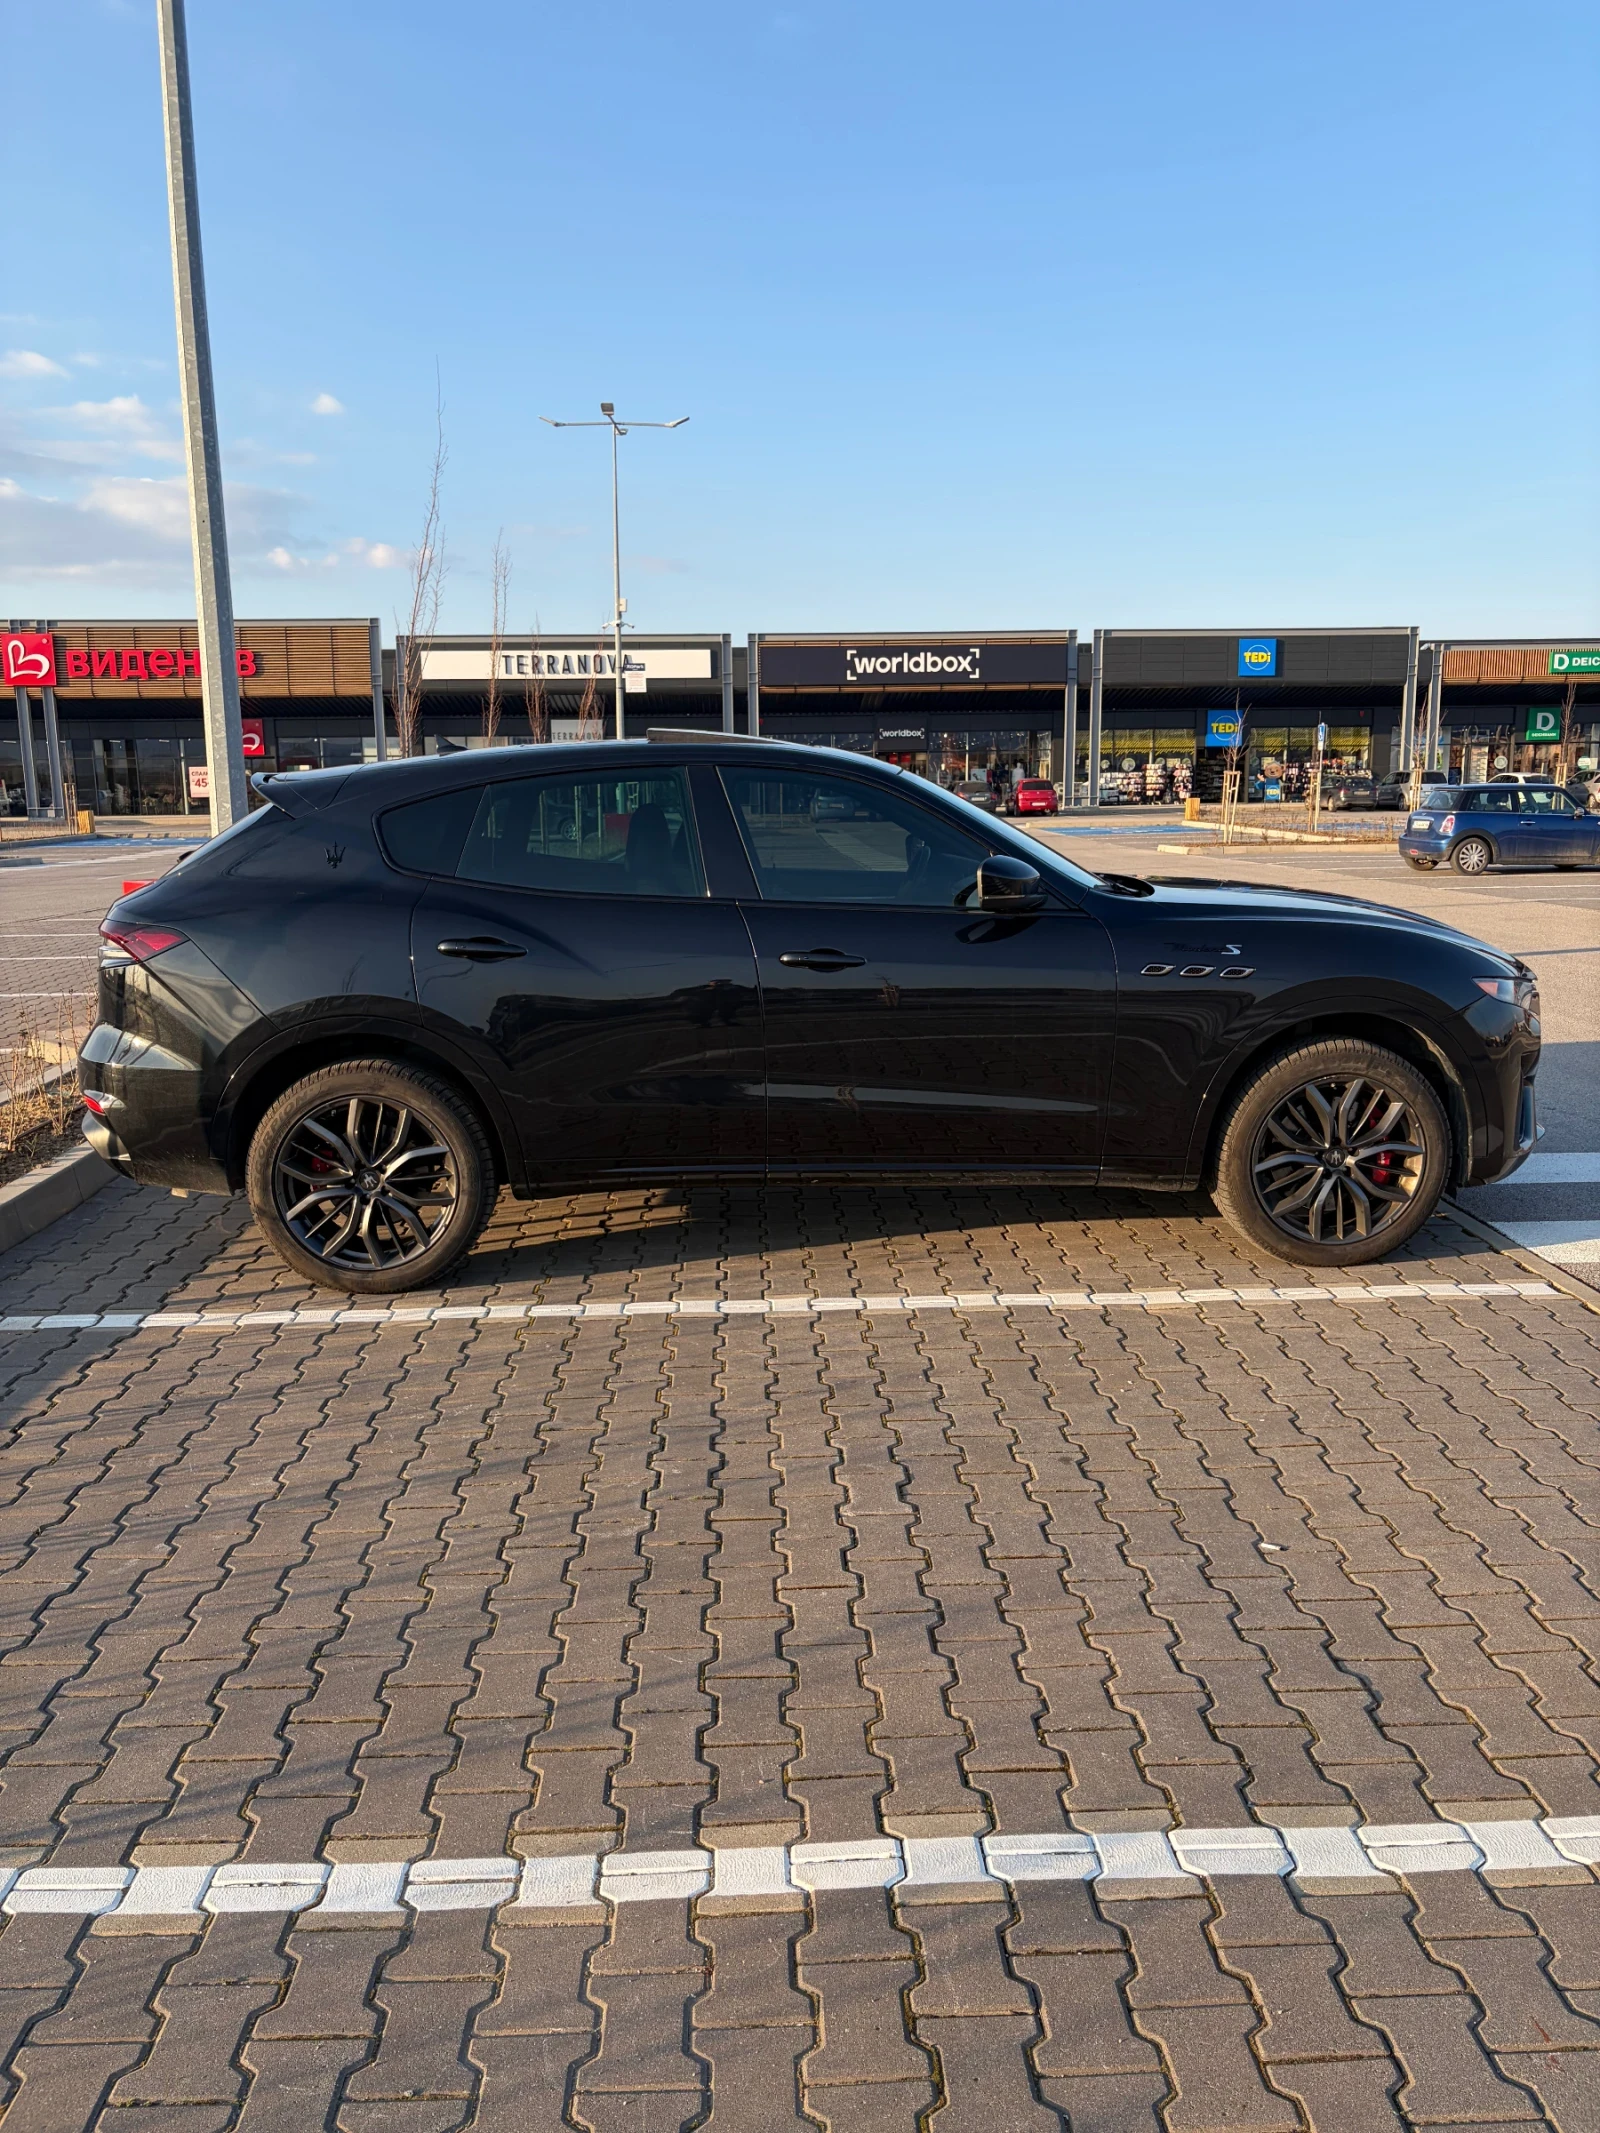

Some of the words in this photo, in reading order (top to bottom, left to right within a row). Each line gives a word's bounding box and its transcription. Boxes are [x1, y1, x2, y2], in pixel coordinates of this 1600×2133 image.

[66, 649, 256, 680] виденв
[502, 654, 629, 674] TERRANOVA
[1243, 652, 1271, 663] TEDi
[1553, 654, 1569, 670] D
[1211, 722, 1239, 733] TEDi
[1536, 712, 1555, 731] D
[192, 778, 209, 787] -45
